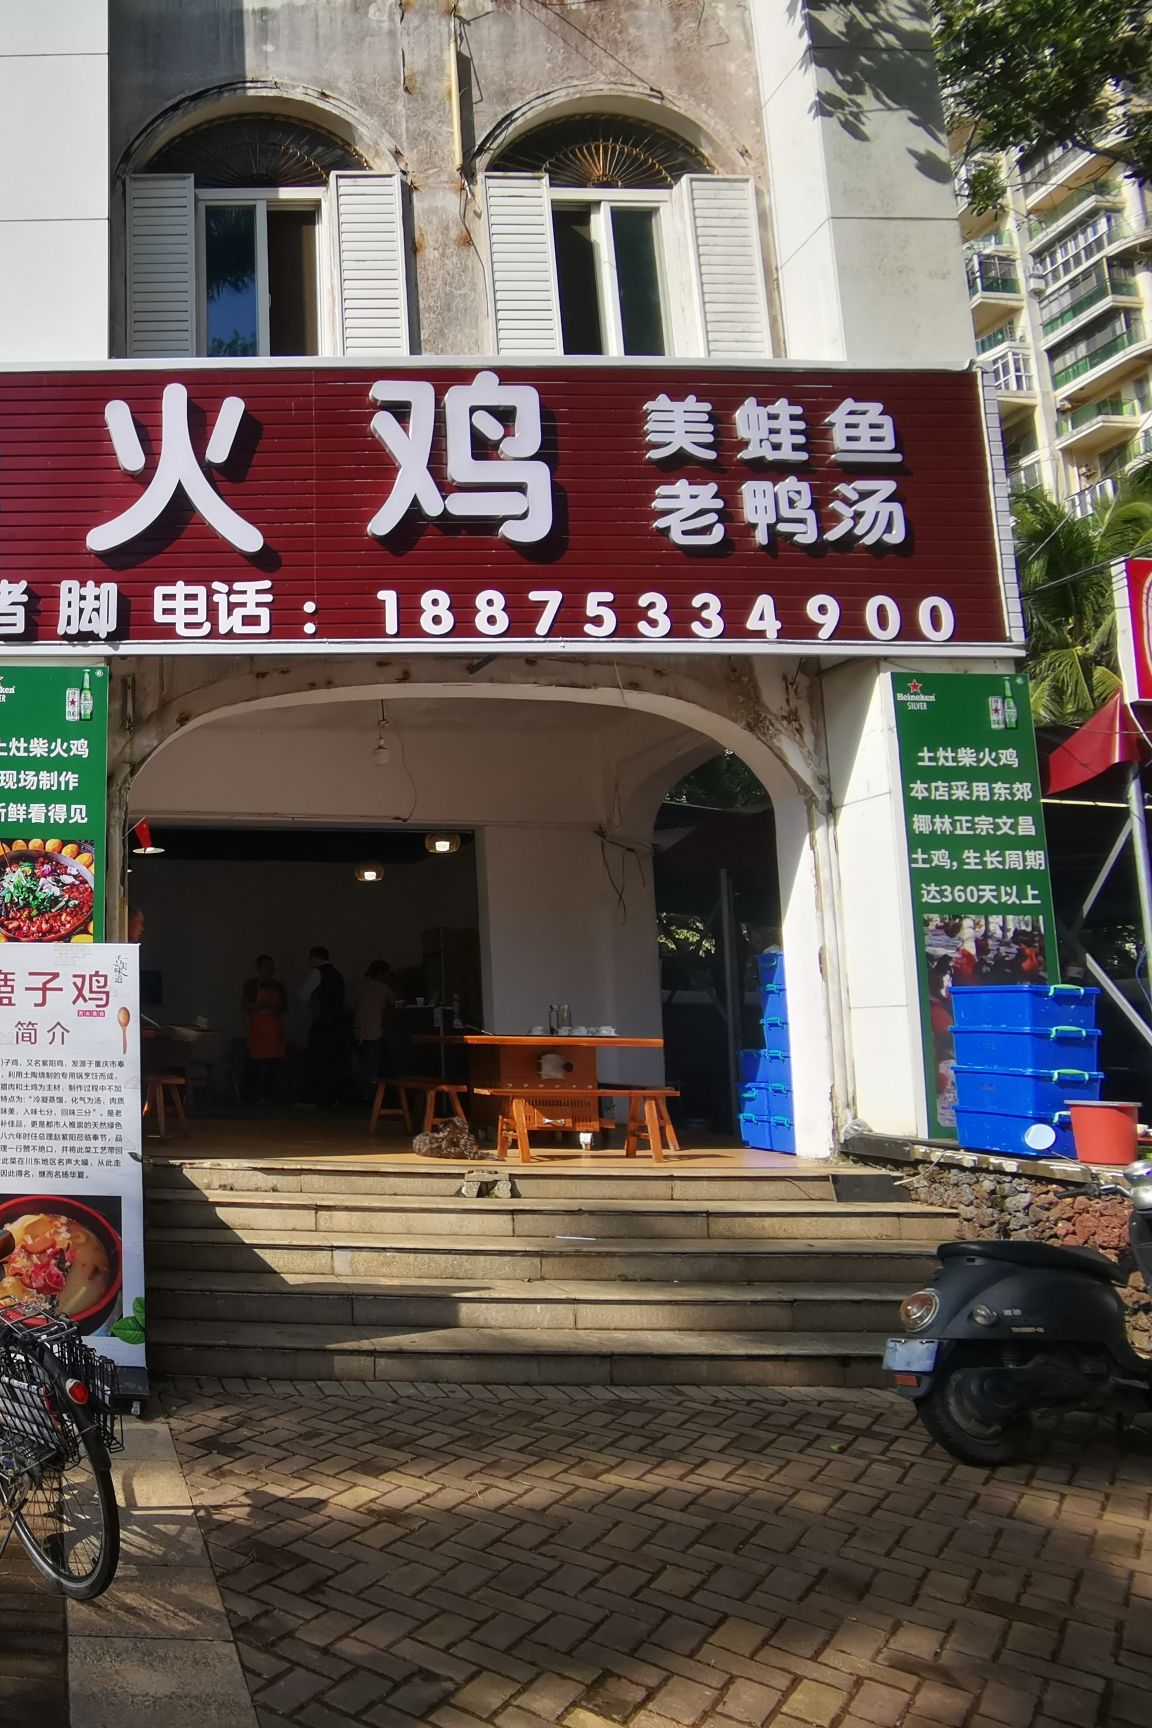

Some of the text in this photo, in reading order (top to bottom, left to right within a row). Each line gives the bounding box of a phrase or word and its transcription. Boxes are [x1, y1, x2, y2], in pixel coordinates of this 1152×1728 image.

[644, 394, 904, 463] 美蛙鱼
[652, 476, 907, 546] 老鸭汤
[376, 589, 955, 642] 18875334900
[897, 693, 936, 702] Heineken
[907, 702, 928, 710] SILVER
[917, 746, 1019, 768] 土灶柴火鸡
[909, 779, 1033, 801] 本店采用东郊
[912, 814, 1037, 836] 椰林正宗文昌
[921, 883, 1042, 905] 达360天以上
[14, 1020, 71, 1046] 简介
